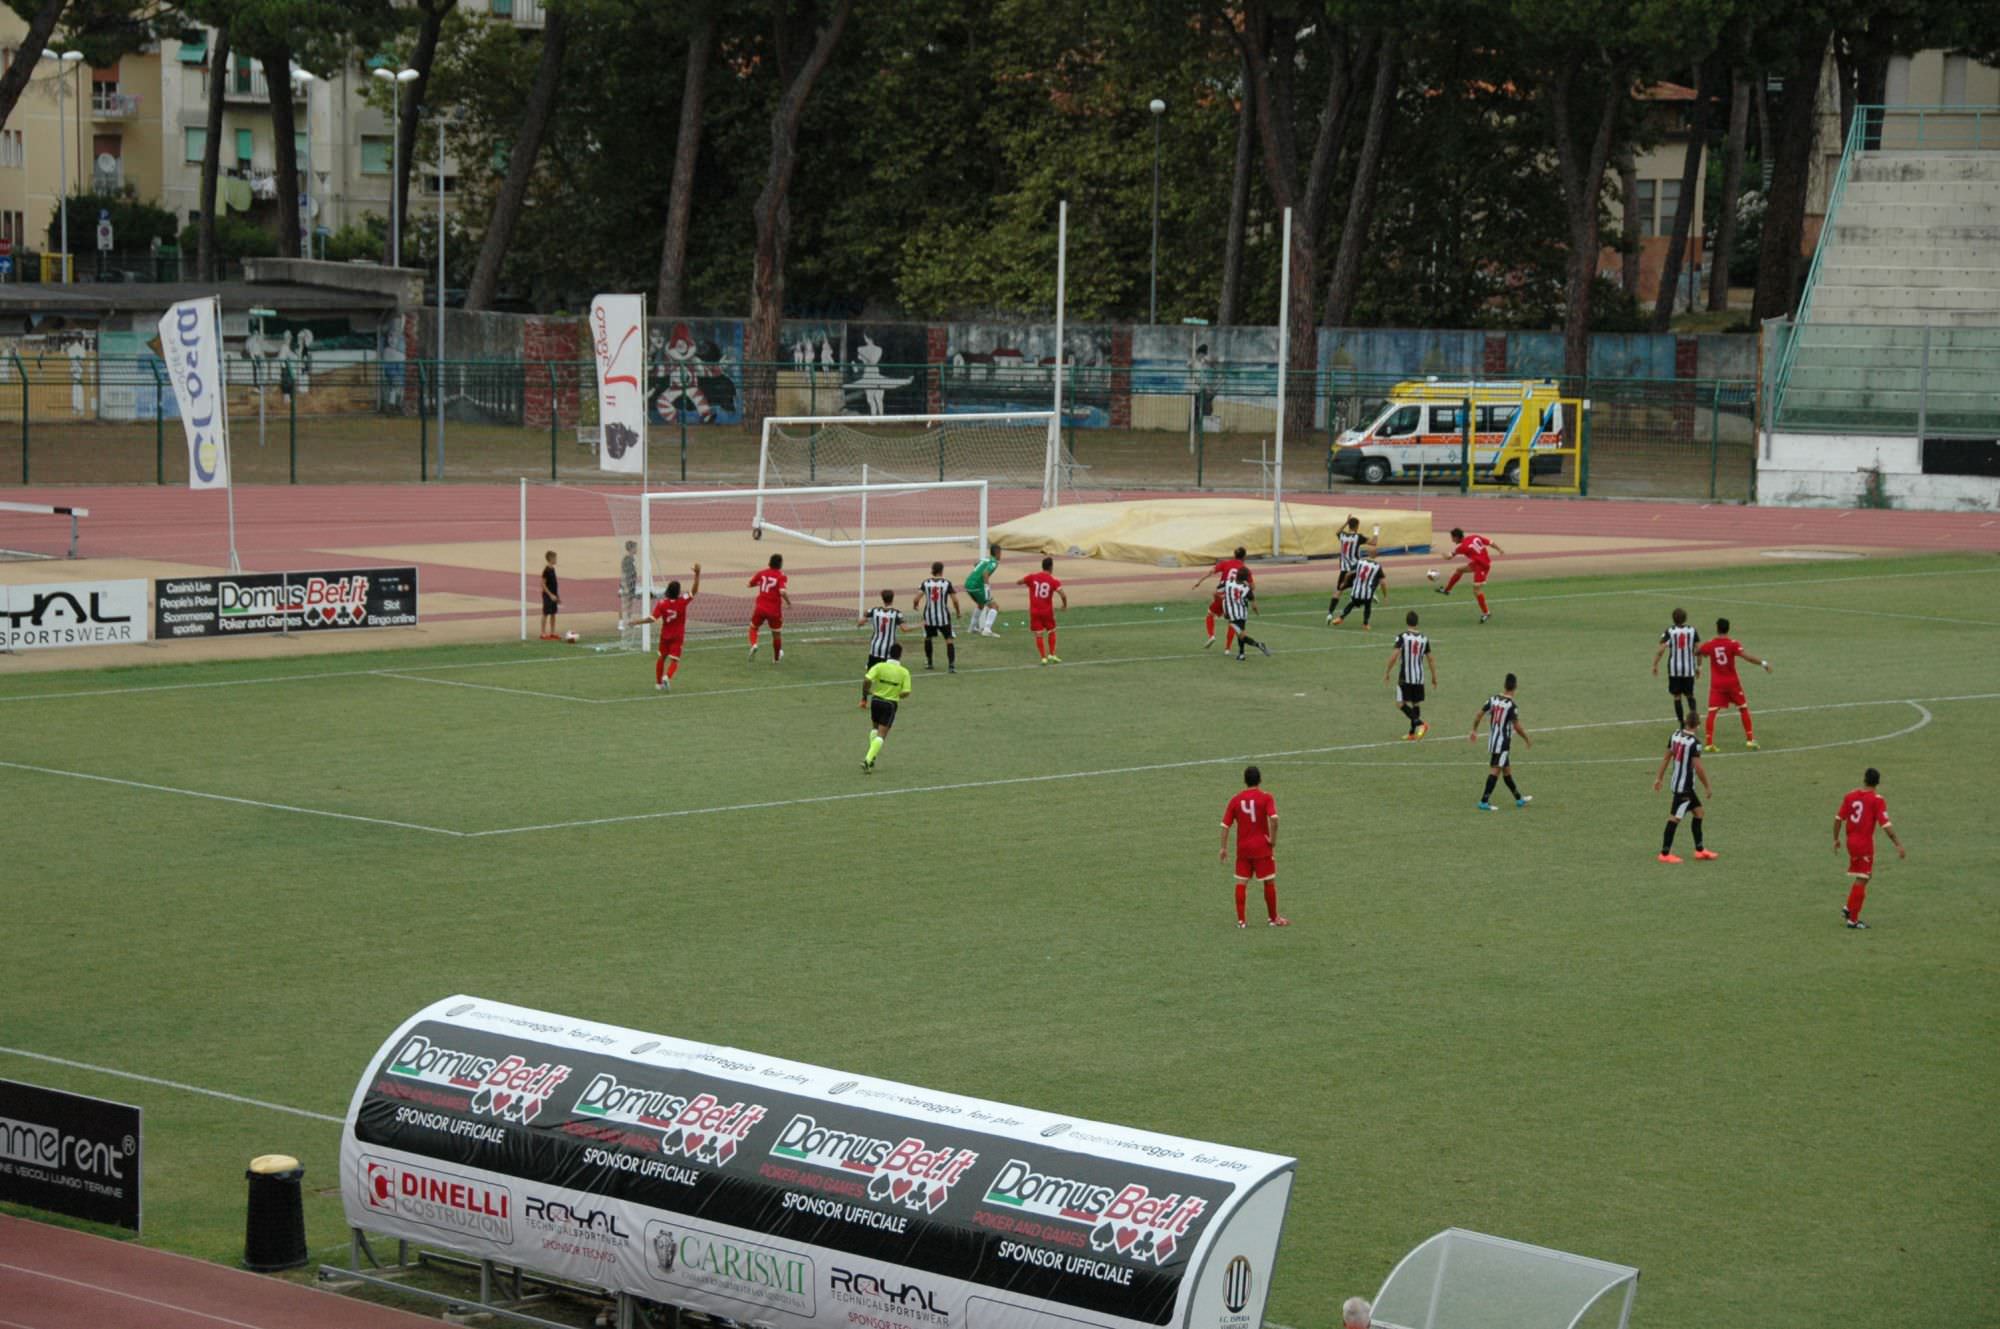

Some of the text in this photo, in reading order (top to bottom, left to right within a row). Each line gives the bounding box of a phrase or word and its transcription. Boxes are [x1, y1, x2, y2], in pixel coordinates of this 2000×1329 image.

[220, 577, 369, 608] DomusBet.it
[1033, 581, 1050, 599] 18
[219, 618, 246, 630] Poker
[248, 616, 265, 628] and
[368, 615, 391, 626] Bingo
[1714, 647, 1728, 665] 5
[1241, 800, 1256, 822] 4
[1851, 800, 1863, 823] 3
[392, 1036, 572, 1098] DomusBet.it
[396, 1107, 504, 1143] SPONSOR UFFICIALE
[577, 1074, 767, 1138] DomusBet.it
[583, 1148, 699, 1186] SPONSOR UFFICIALE
[774, 1115, 978, 1185] DomusBet.it
[15, 1166, 49, 1182] VEICOLI
[51, 1173, 82, 1189] LUNGO
[84, 1180, 123, 1199] TERMINE
[402, 1172, 507, 1218] DINELLI
[987, 1160, 1206, 1234] DomusBet.it
[401, 1199, 509, 1239] COSTRUZIONI
[526, 1196, 629, 1239] ROYAL
[782, 1192, 907, 1234] SPONSOR UFFICIALE
[1014, 1221, 1041, 1236] AND
[1042, 1225, 1087, 1248] GAMES
[680, 1235, 806, 1295] CARISMI
[998, 1241, 1133, 1285] SPONSOR UFFICIALE
[831, 1267, 949, 1316] ROYAL
